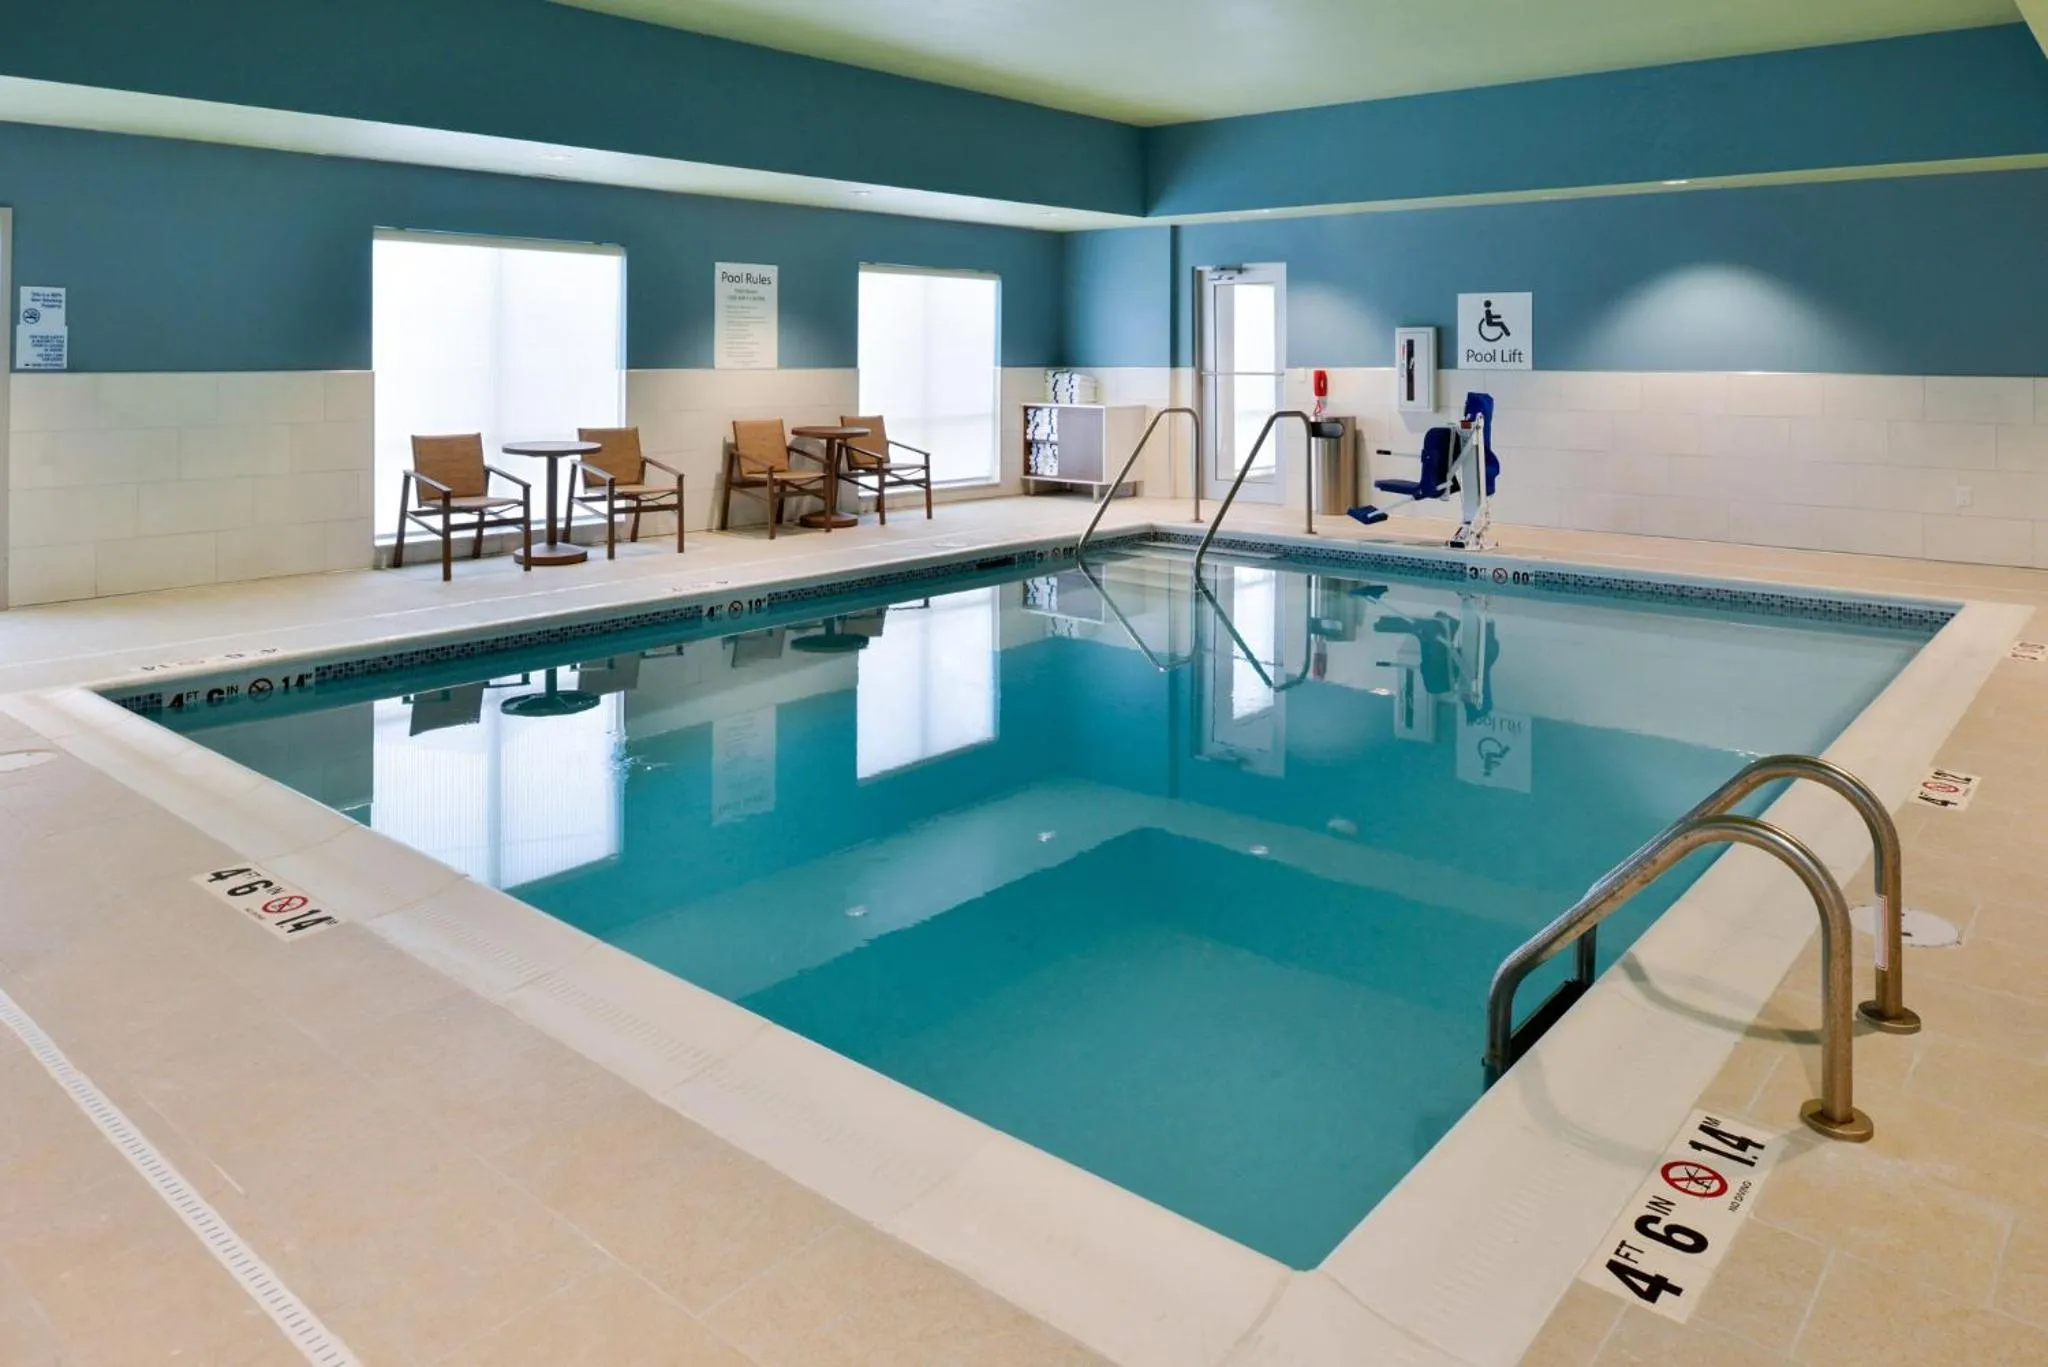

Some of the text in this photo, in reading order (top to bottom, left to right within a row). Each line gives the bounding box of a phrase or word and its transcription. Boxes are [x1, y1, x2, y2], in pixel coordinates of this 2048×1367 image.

[722, 271, 772, 285] Pool Rules
[1466, 349, 1524, 363] Pool Lift
[1728, 1180, 1753, 1212] NO DIVING
